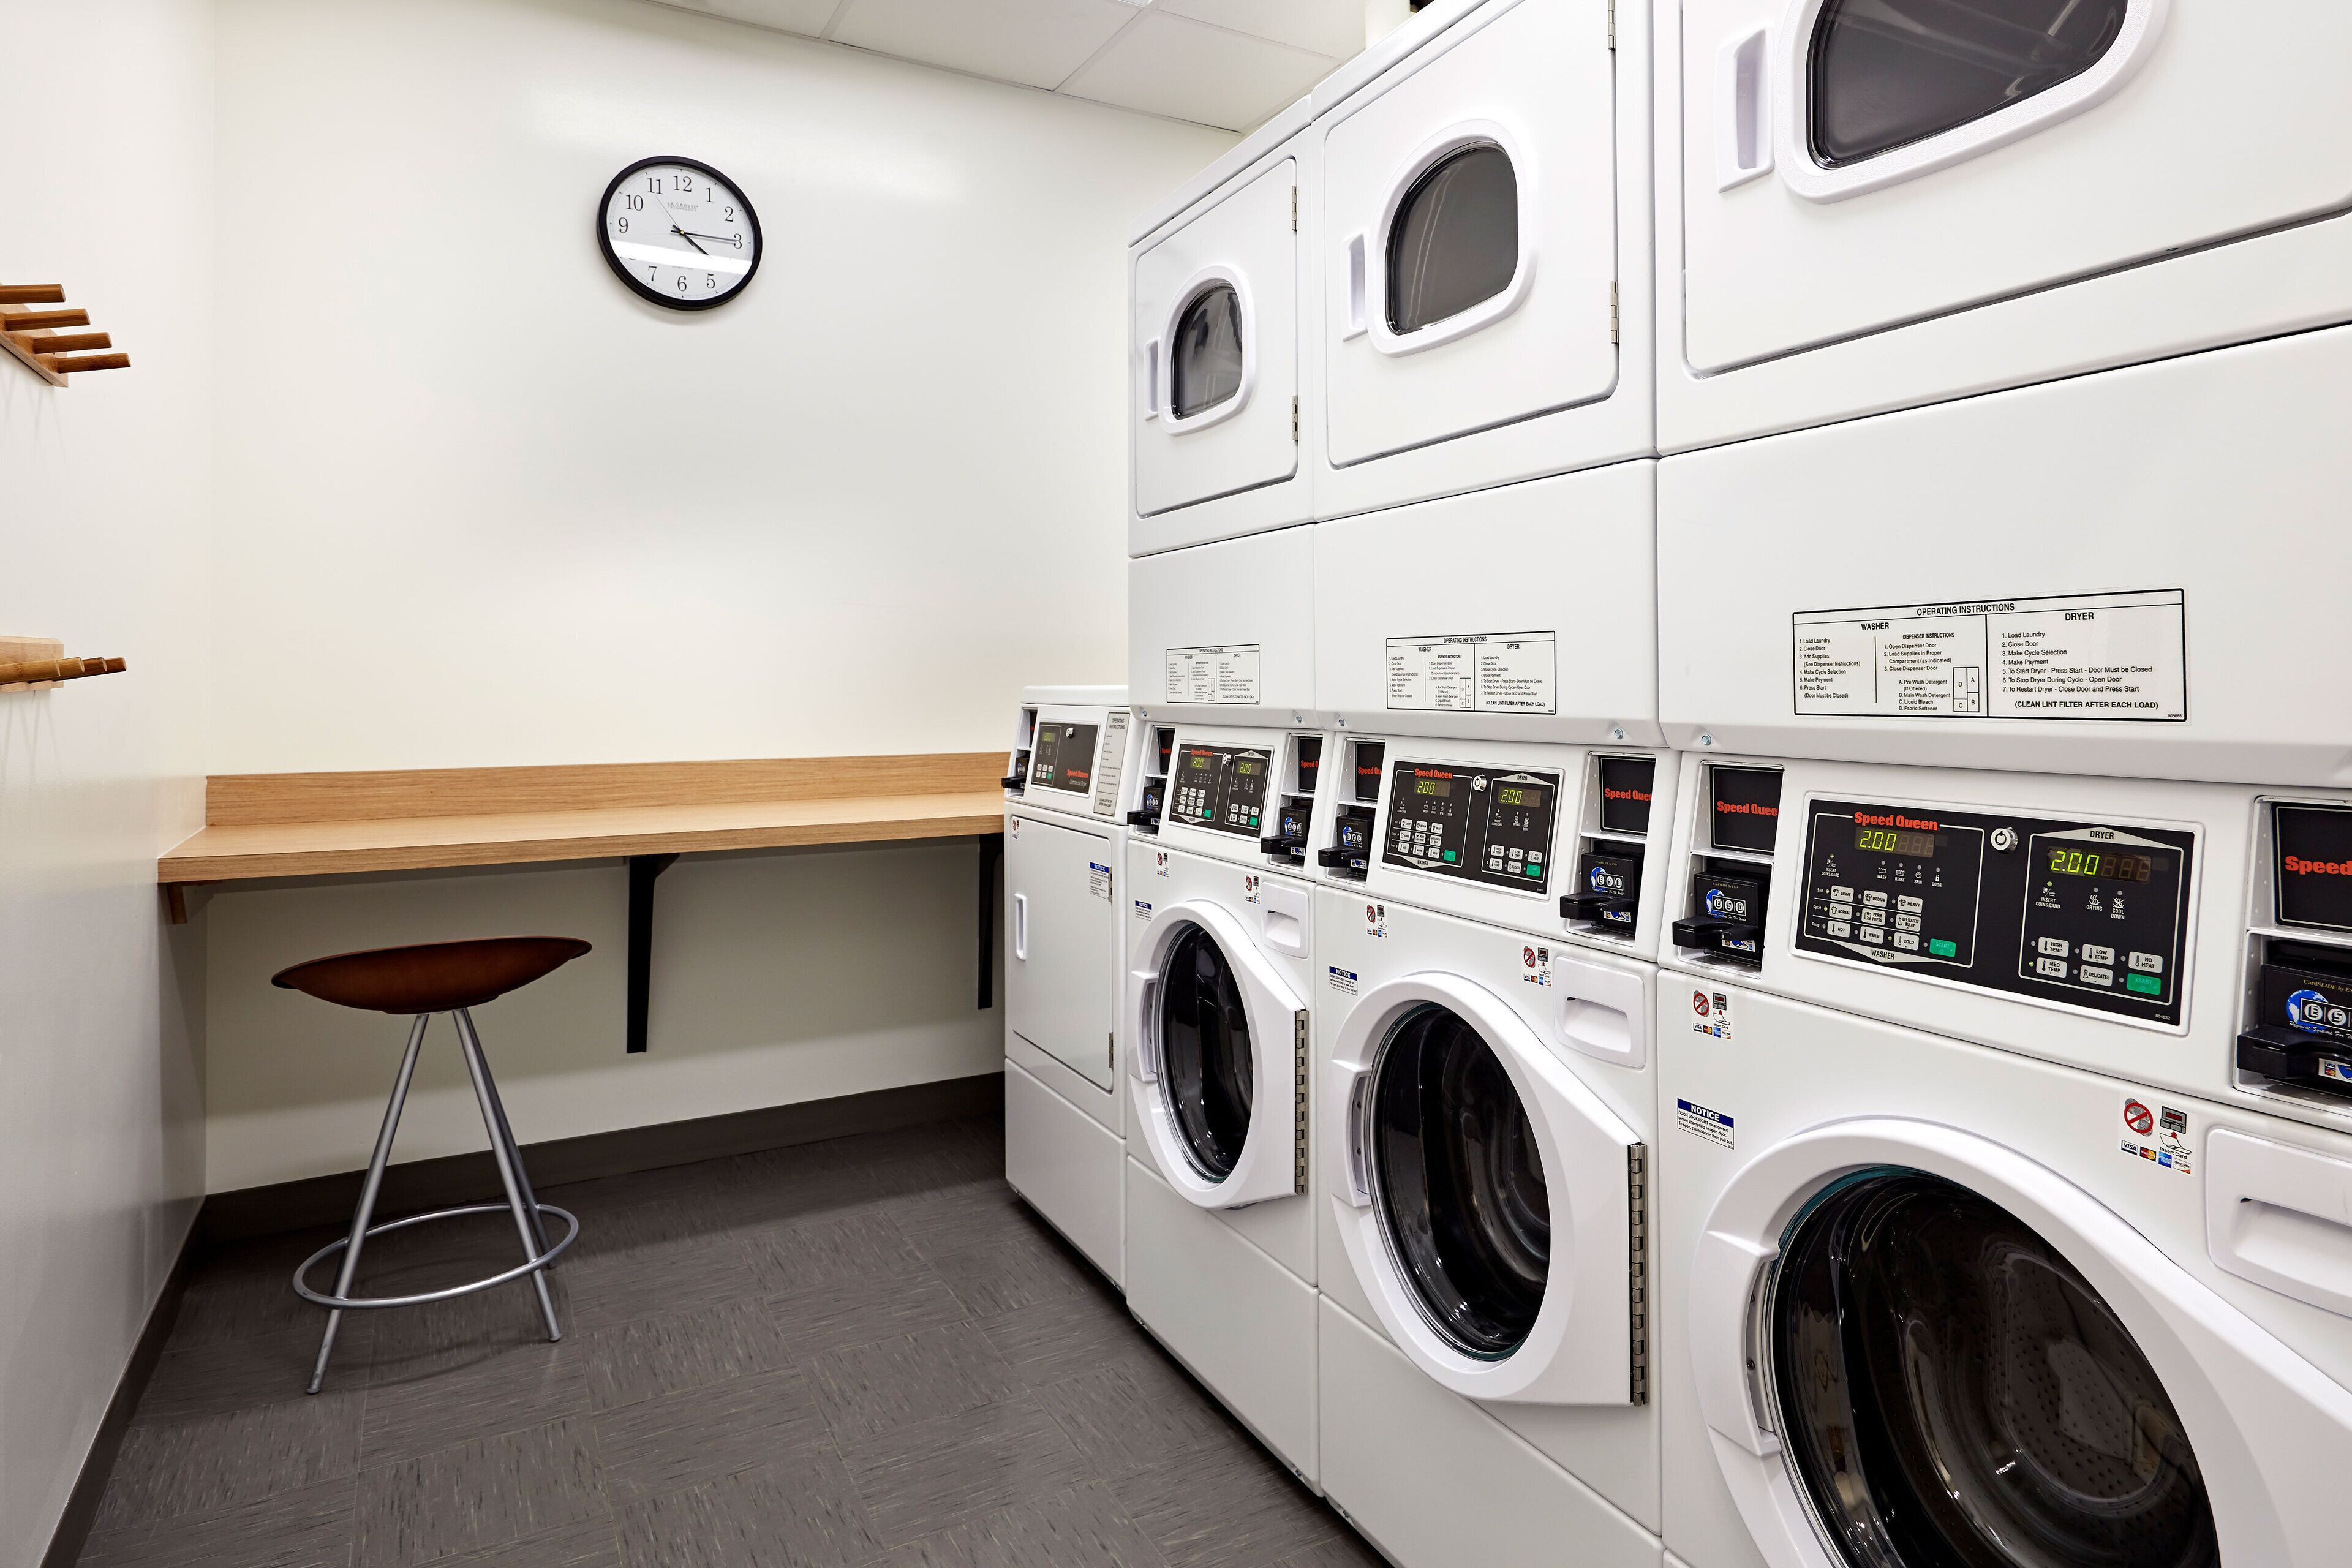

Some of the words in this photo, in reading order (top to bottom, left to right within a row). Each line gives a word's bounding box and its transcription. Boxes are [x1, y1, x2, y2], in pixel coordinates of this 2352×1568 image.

[647, 178, 663, 195] 11
[673, 175, 692, 192] 12
[625, 194, 643, 211] 10
[706, 187, 714, 203] 1
[725, 206, 734, 222] 2
[619, 217, 628, 233] 9
[733, 233, 742, 249] 3
[647, 266, 657, 282] 7
[706, 273, 715, 289] 5
[677, 276, 687, 292] 6
[1917, 606, 1958, 616] OPERATING
[1959, 603, 2015, 613] INSTRUCTIONS
[2065, 612, 2094, 621] DRYER
[1861, 622, 1889, 630] WASHER
[2134, 701, 2158, 710] LOAD)
[1239, 763, 1252, 774] 2.00
[1357, 766, 1374, 775] Speed
[1414, 768, 1433, 777] Speed
[1434, 770, 1453, 779] Queen
[1417, 781, 1436, 794] 2.00
[1605, 788, 1631, 800] Speed
[1501, 789, 1523, 804] 2.00
[1716, 801, 1749, 814] Speed
[1751, 803, 1778, 816] Quee
[1854, 812, 1894, 826] Speed
[1896, 815, 1938, 831] Queen
[1860, 830, 1897, 851] 2.00
[2090, 830, 2114, 840] DRYER
[2051, 851, 2100, 875] 2.00
[2285, 856, 2352, 876] Speed
[2035, 901, 2060, 910] COINS/CARD
[1871, 949, 1894, 960] WASHER
[1336, 968, 1351, 978] NOTICE
[2303, 979, 2337, 990] CardSLIDE
[2288, 1020, 2311, 1031] Payment
[2312, 1026, 2333, 1035] Systems
[1691, 1104, 1720, 1122] NOTICE
[2123, 1142, 2137, 1152] VISA
[2160, 1147, 2174, 1156] Insert
